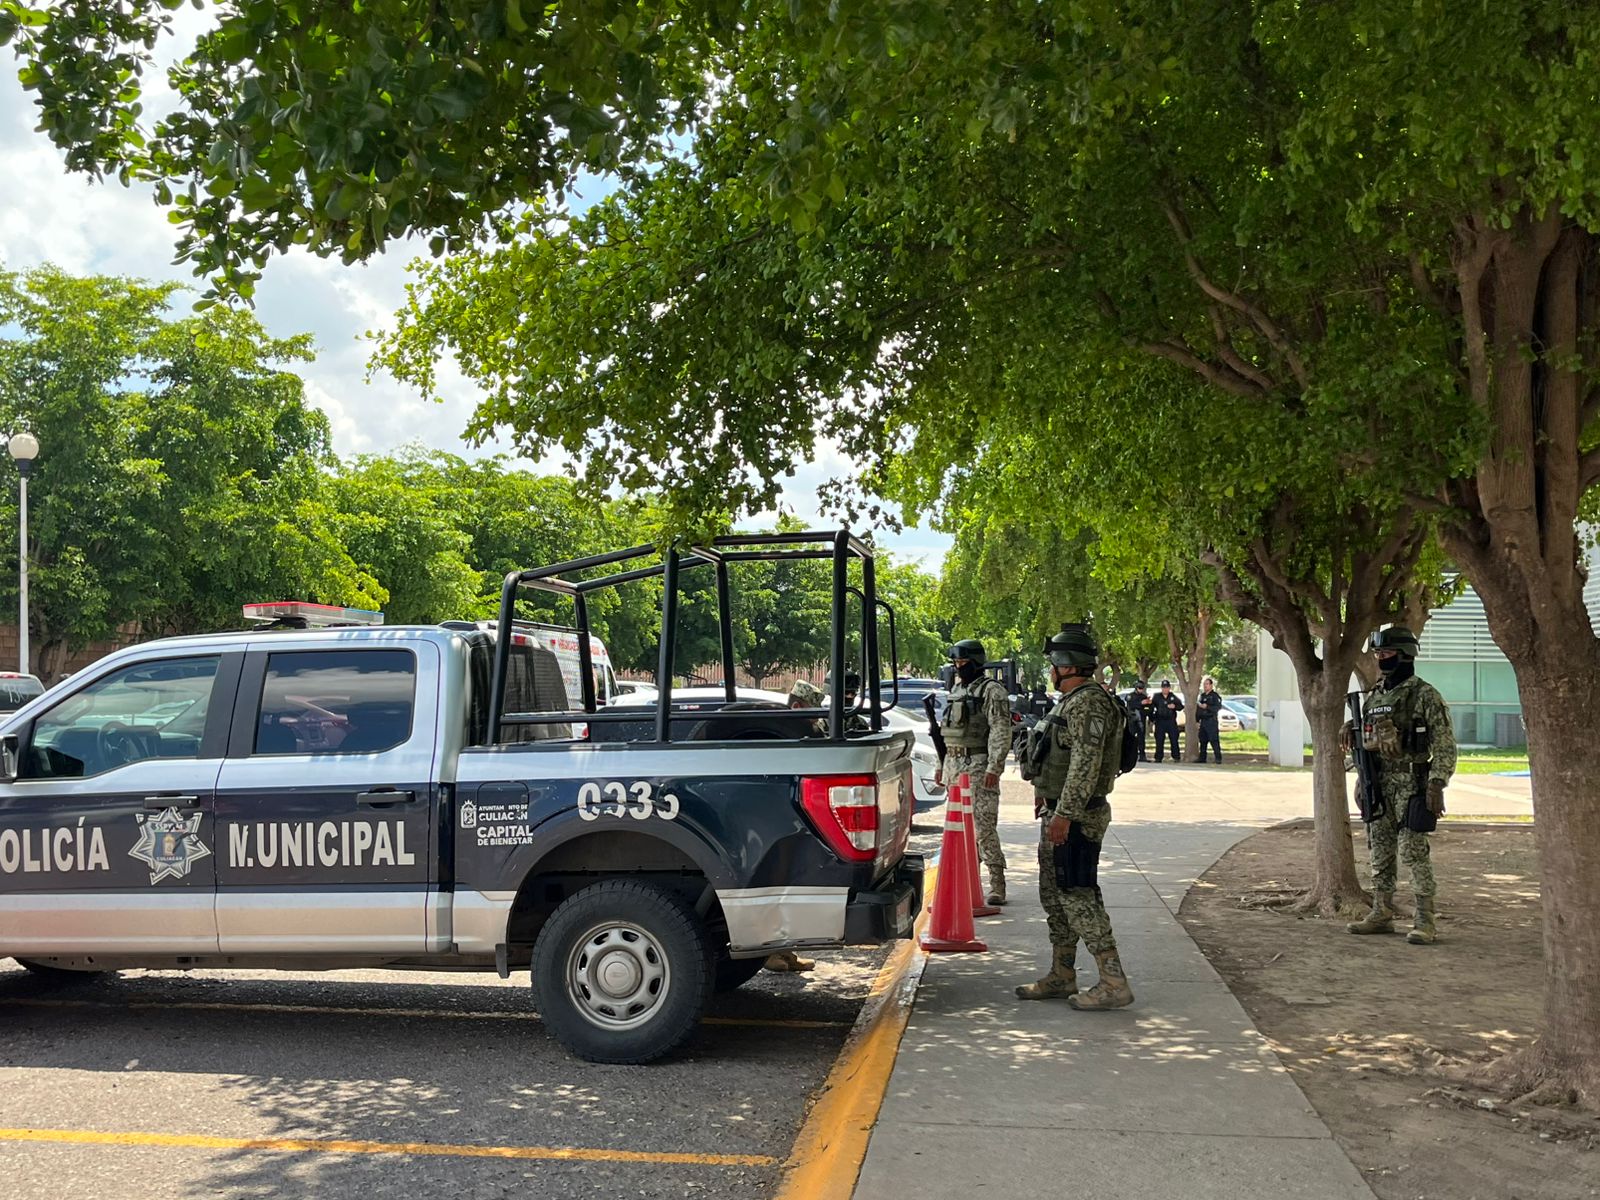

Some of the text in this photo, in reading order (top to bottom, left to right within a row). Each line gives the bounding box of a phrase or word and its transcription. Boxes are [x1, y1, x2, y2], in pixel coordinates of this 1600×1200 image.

[477, 825, 534, 838] CAPITAL
[477, 837, 533, 846] DE BIENESTAR
